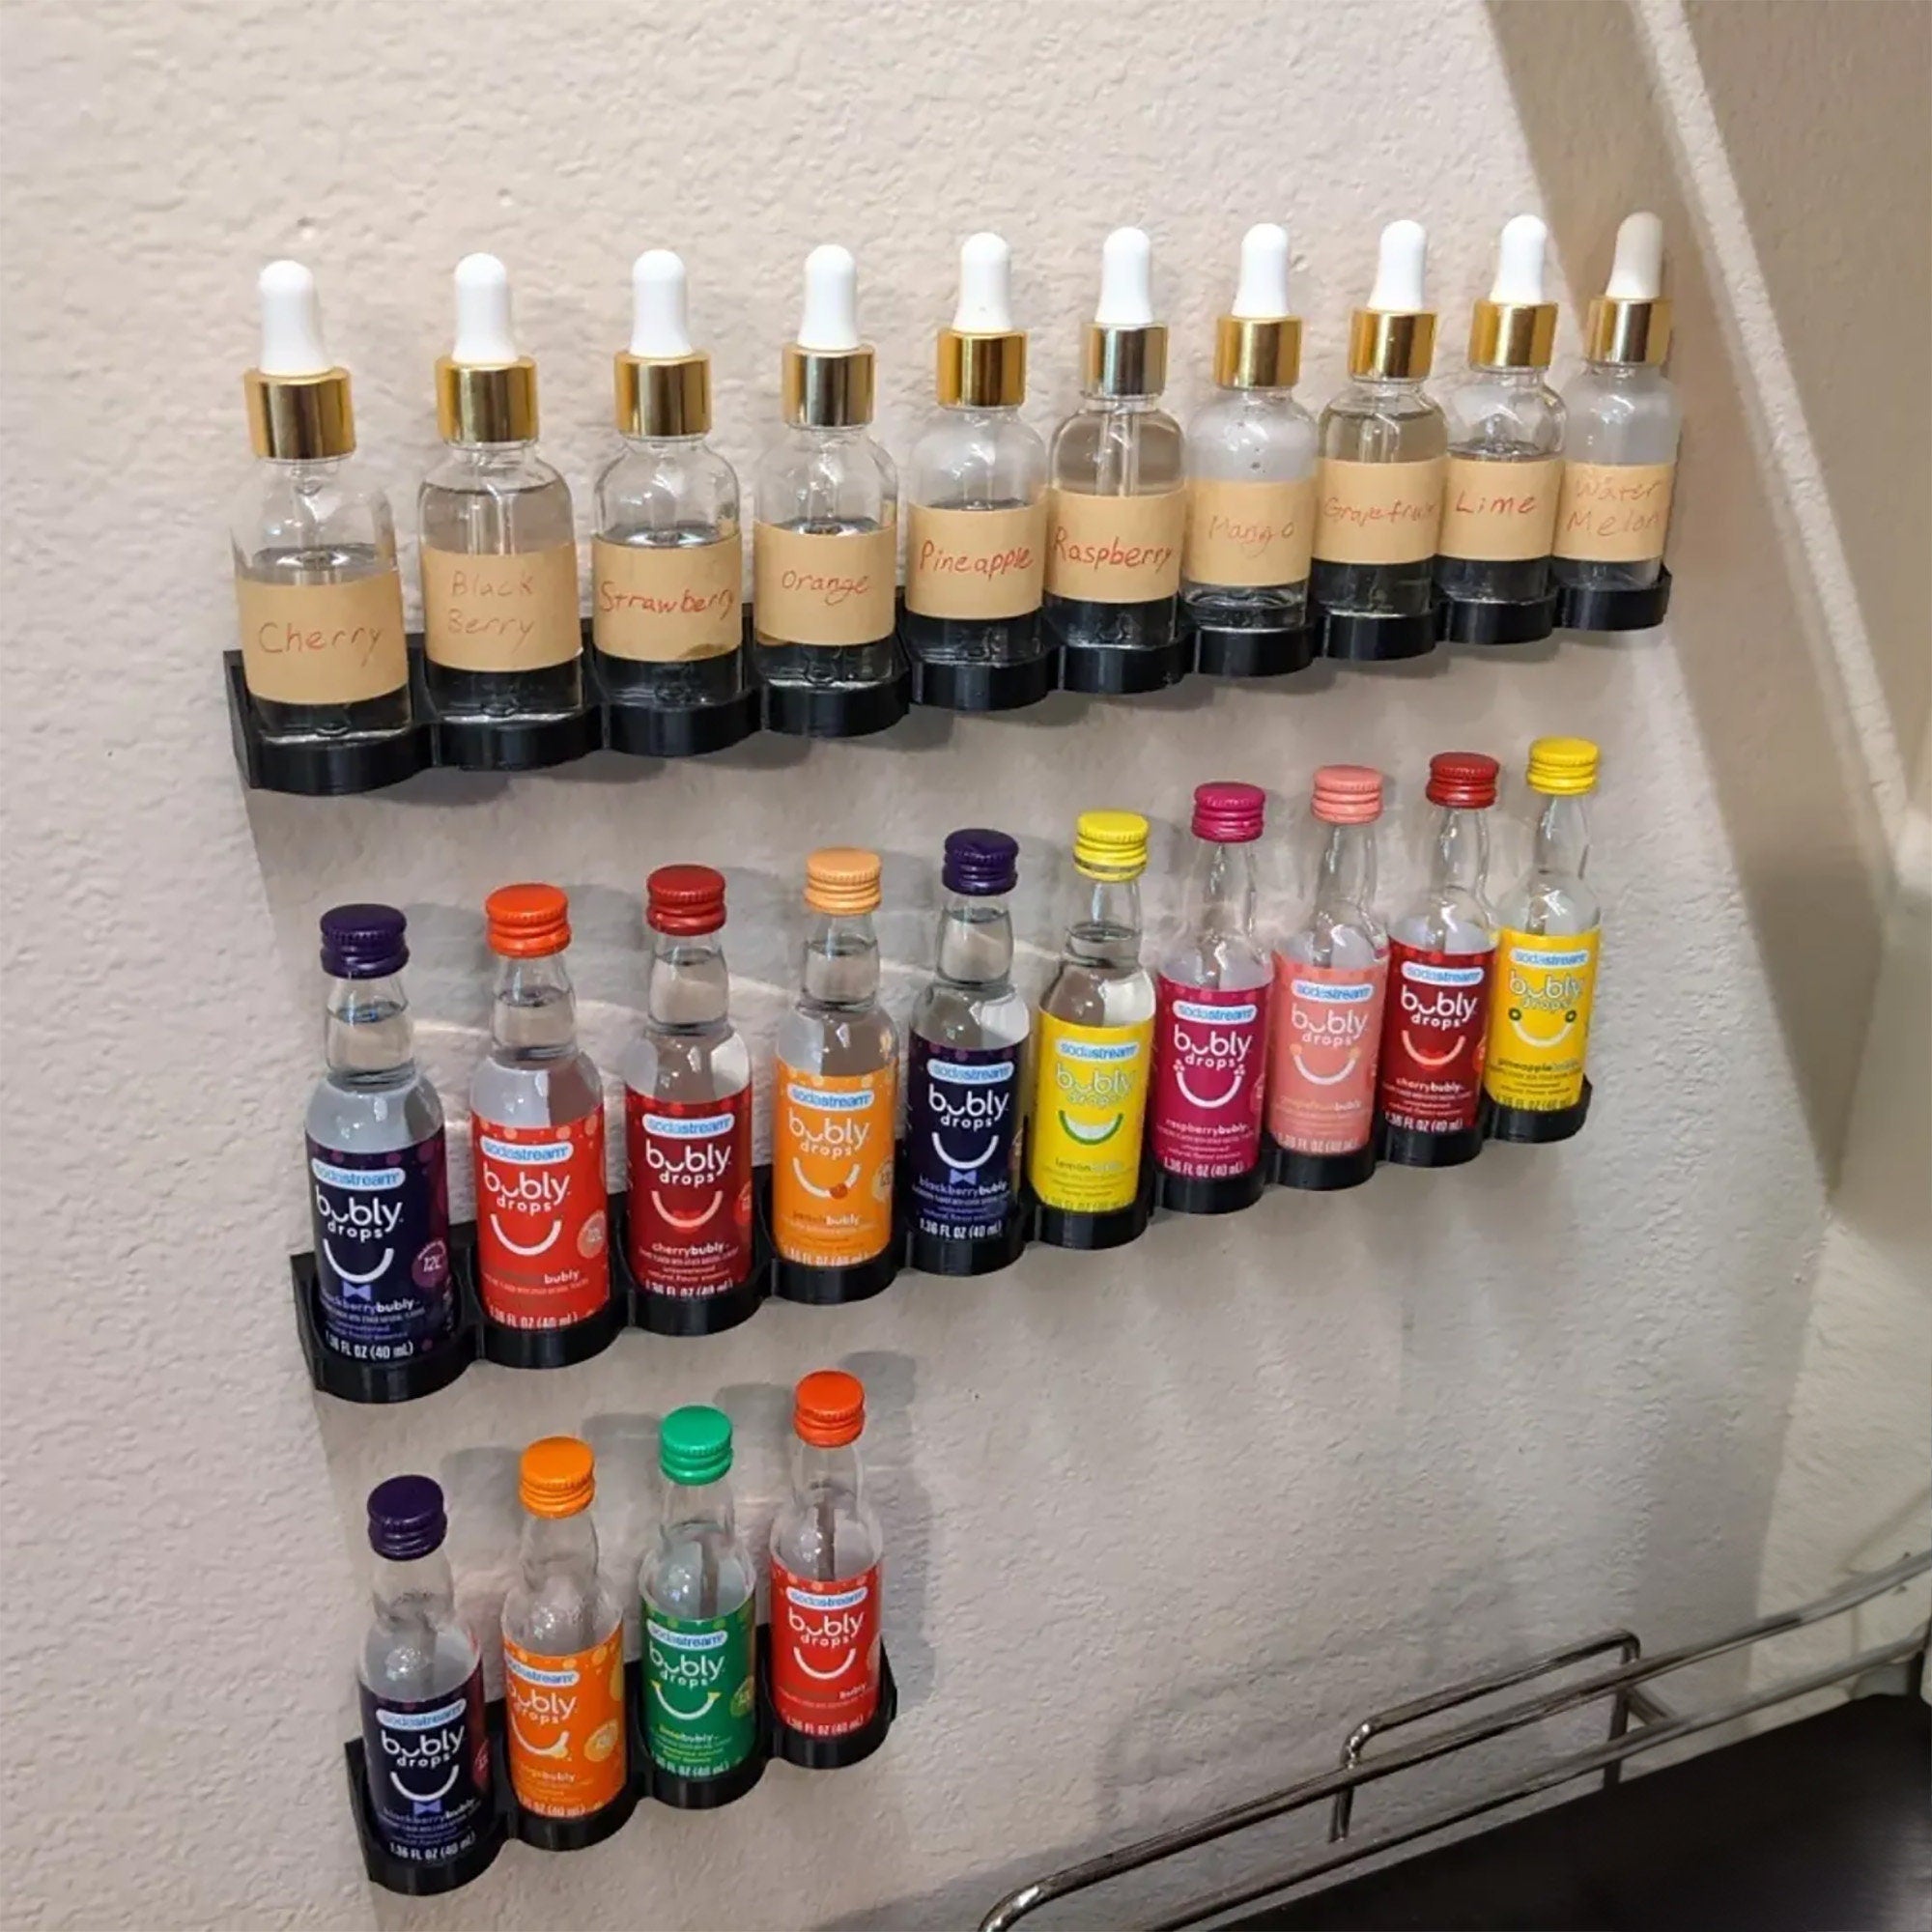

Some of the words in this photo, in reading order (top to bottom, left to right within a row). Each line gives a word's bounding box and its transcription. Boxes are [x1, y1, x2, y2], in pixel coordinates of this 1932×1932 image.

[1456, 490, 1536, 514] Lime
[1577, 477, 1662, 502] Water
[1209, 515, 1295, 558] Mango
[1567, 511, 1661, 536] Melon
[919, 540, 1035, 581] Pineapple
[1052, 526, 1174, 574] Raspberry
[452, 571, 534, 597] Black
[781, 570, 869, 606] Orange
[258, 622, 383, 667] Cherry
[446, 609, 535, 653] Berry
[1401, 984, 1478, 1021] bubly
[1292, 1004, 1368, 1038] bubly
[1411, 1014, 1461, 1031] drops
[1061, 1041, 1138, 1059] sodastream
[1174, 1024, 1252, 1062] bubly
[1302, 1032, 1351, 1048] drops
[1185, 1053, 1236, 1070] drops
[928, 1083, 1009, 1121] bubly
[789, 1108, 869, 1151] bubly
[941, 1114, 992, 1132] drops
[645, 1139, 731, 1176] bubly
[801, 1140, 852, 1160] drops
[484, 1161, 571, 1205] bubly
[660, 1171, 714, 1188] drops
[316, 1185, 403, 1232] bubly
[497, 1196, 552, 1216] drops
[327, 1221, 383, 1242] drops
[940, 1224, 950, 1237] FL
[953, 1226, 966, 1239] OZ
[788, 1606, 864, 1637] bubly
[801, 1634, 849, 1648] drops
[650, 1640, 724, 1681] bubly
[660, 1670, 708, 1690] drops
[382, 1725, 465, 1755] bubly
[397, 1754, 450, 1769] drops
